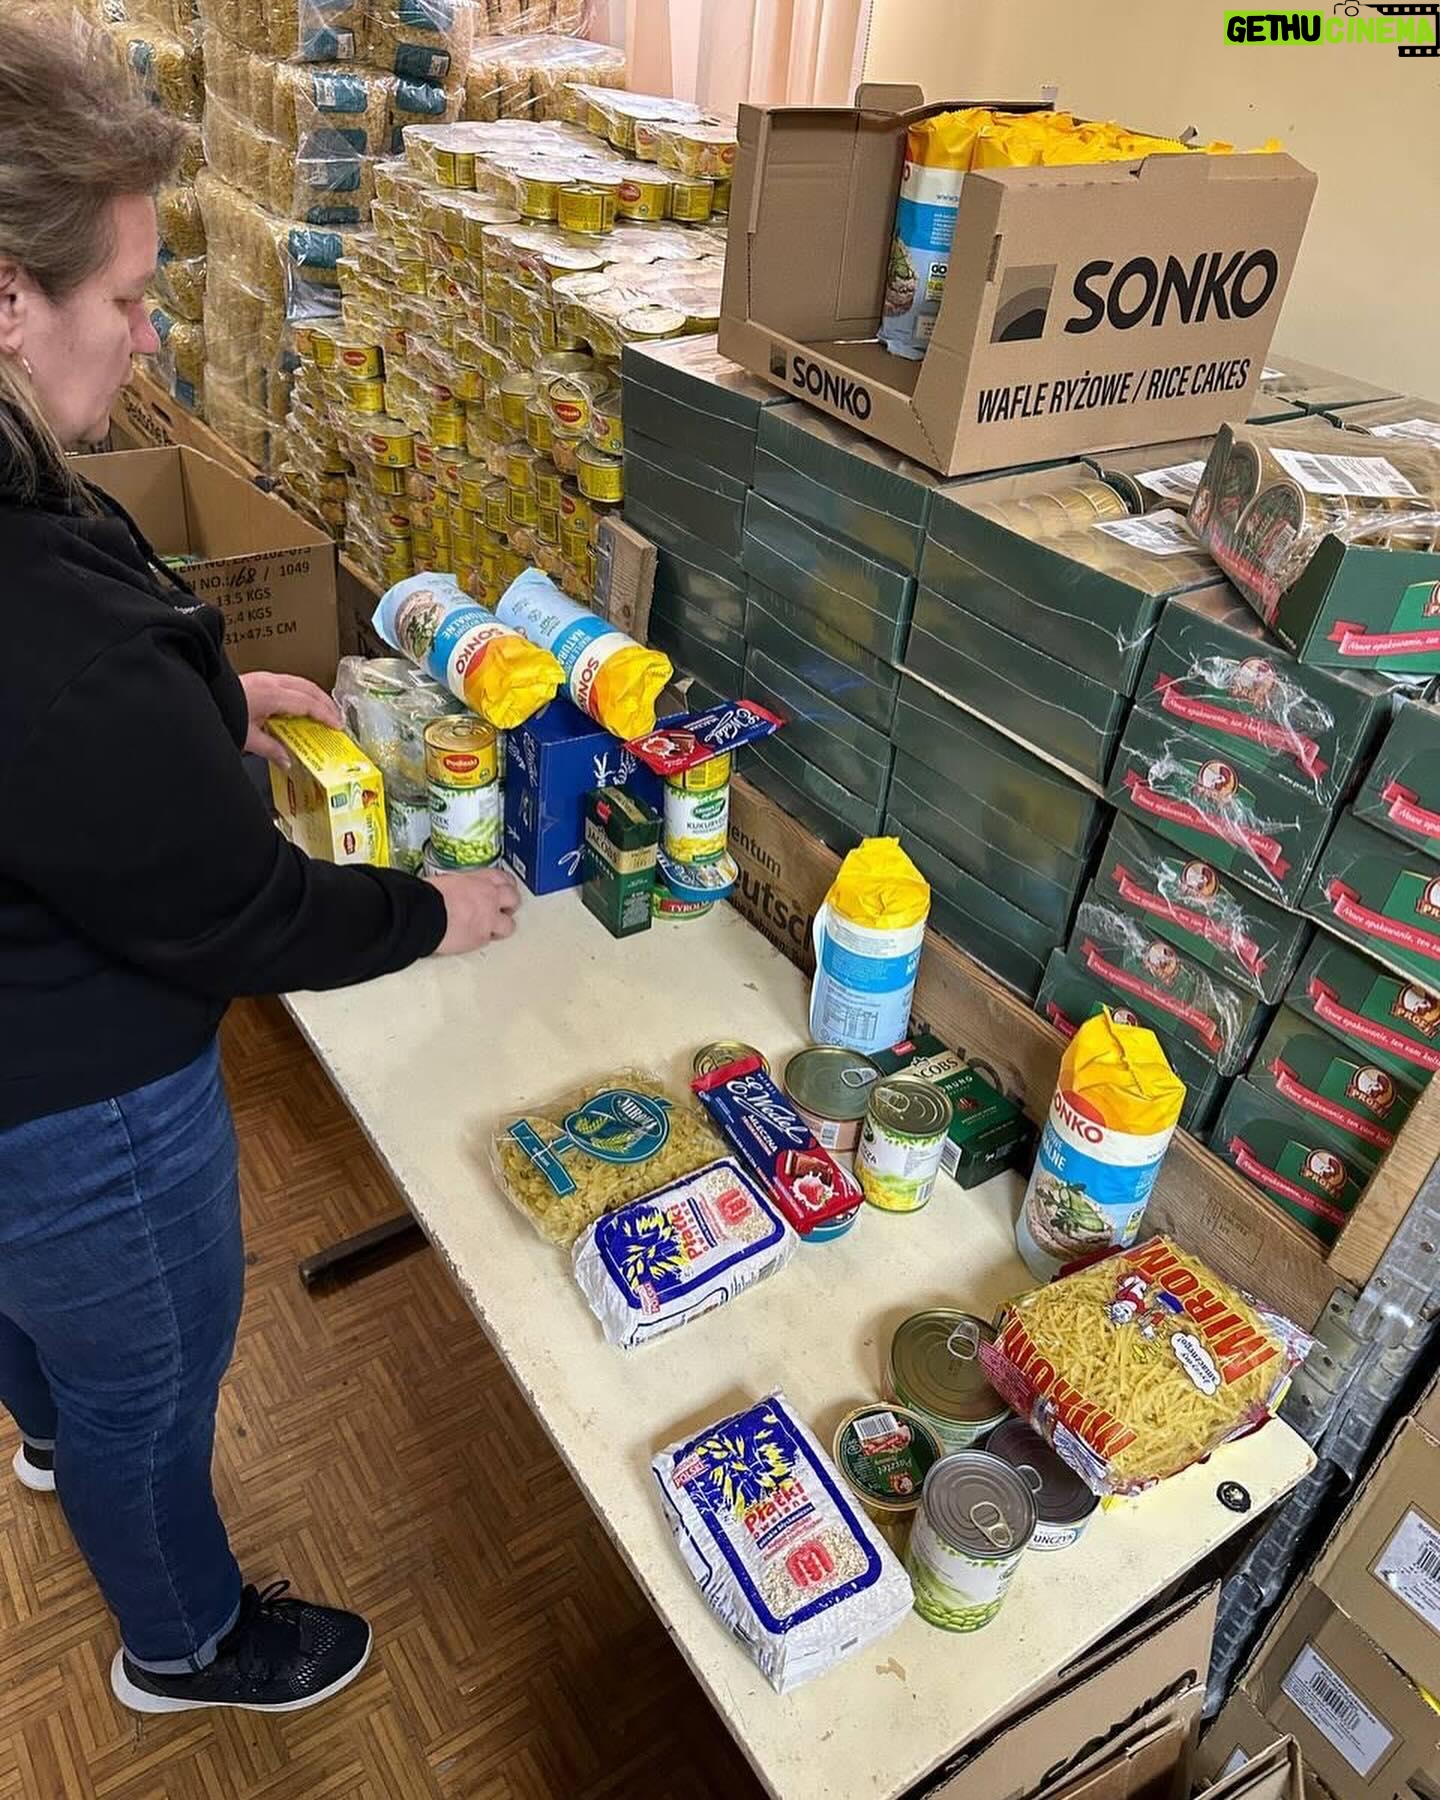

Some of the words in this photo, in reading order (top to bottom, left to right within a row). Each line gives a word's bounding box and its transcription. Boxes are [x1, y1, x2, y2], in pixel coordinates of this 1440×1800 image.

[1064, 249, 1278, 334] SONKO
[793, 356, 872, 420] SONKO
[977, 383, 1049, 424] WAFLE
[1049, 370, 1134, 413] RYŻOWE
[1149, 364, 1193, 401] RICE
[1196, 358, 1251, 394] CAKES
[280, 561, 310, 577] 1049
[217, 592, 244, 608] 13.5
[246, 588, 272, 601] KGS
[248, 607, 272, 621] KGS
[277, 621, 297, 634] CM
[669, 1203, 703, 1261] Płatki
[1122, 1234, 1280, 1386] MIRON
[674, 1461, 707, 1489] POLSKI
[744, 1477, 805, 1534] Płatki
